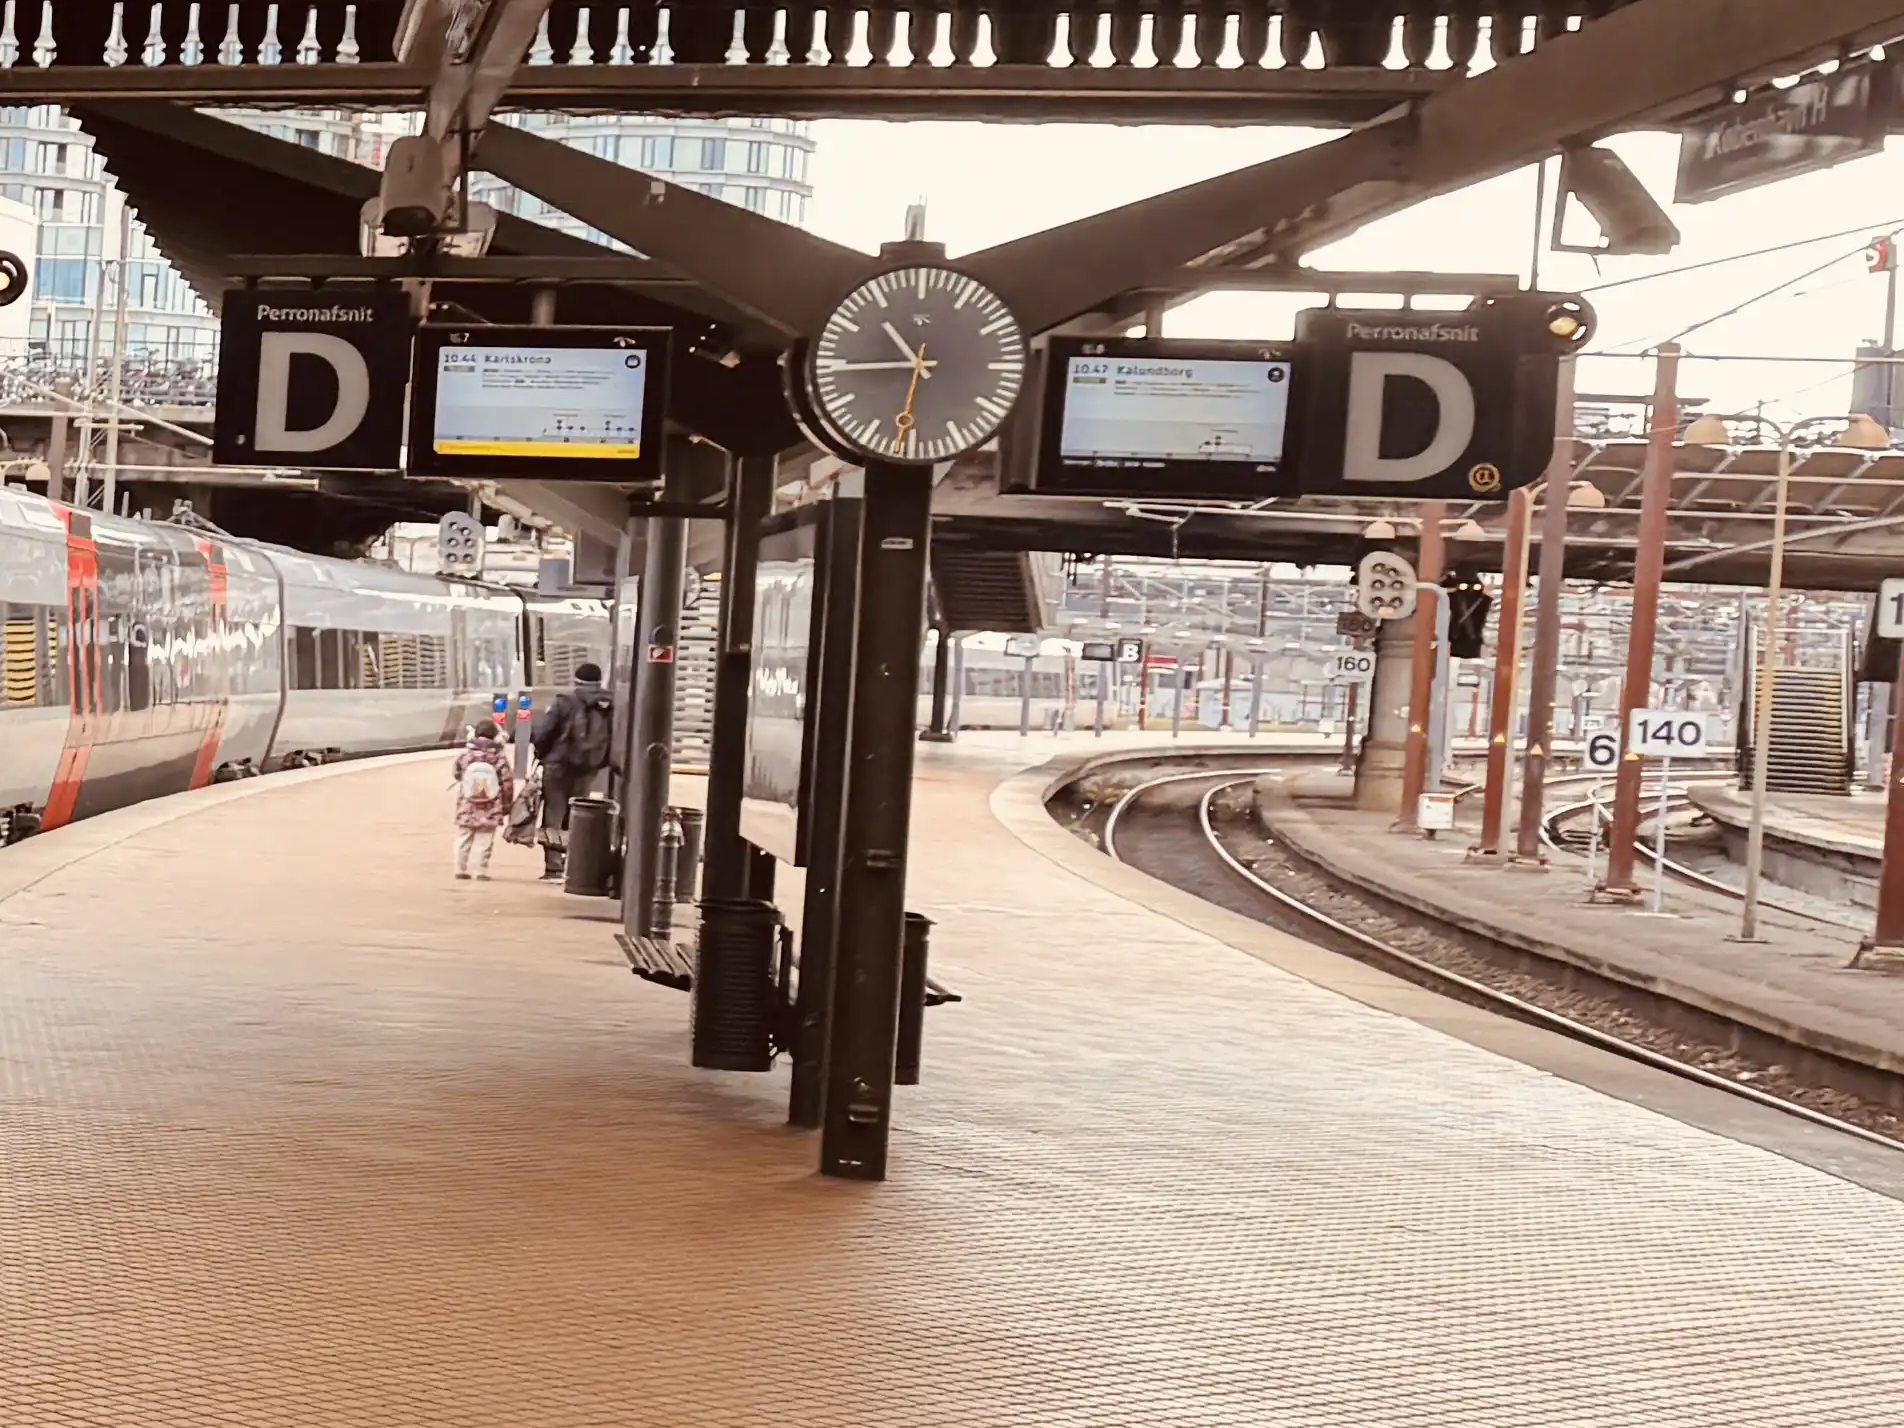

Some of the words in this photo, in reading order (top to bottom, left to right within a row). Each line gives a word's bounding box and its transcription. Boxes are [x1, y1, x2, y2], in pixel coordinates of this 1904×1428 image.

[257, 304, 374, 323] Perronafsnit
[1346, 323, 1480, 342] Perronafsnit
[1116, 364, 1194, 379] Kalundborg
[254, 332, 370, 453] D
[1342, 352, 1475, 482] D
[1120, 644, 1140, 662] B
[1337, 656, 1371, 672] 160
[1637, 719, 1702, 746] 140
